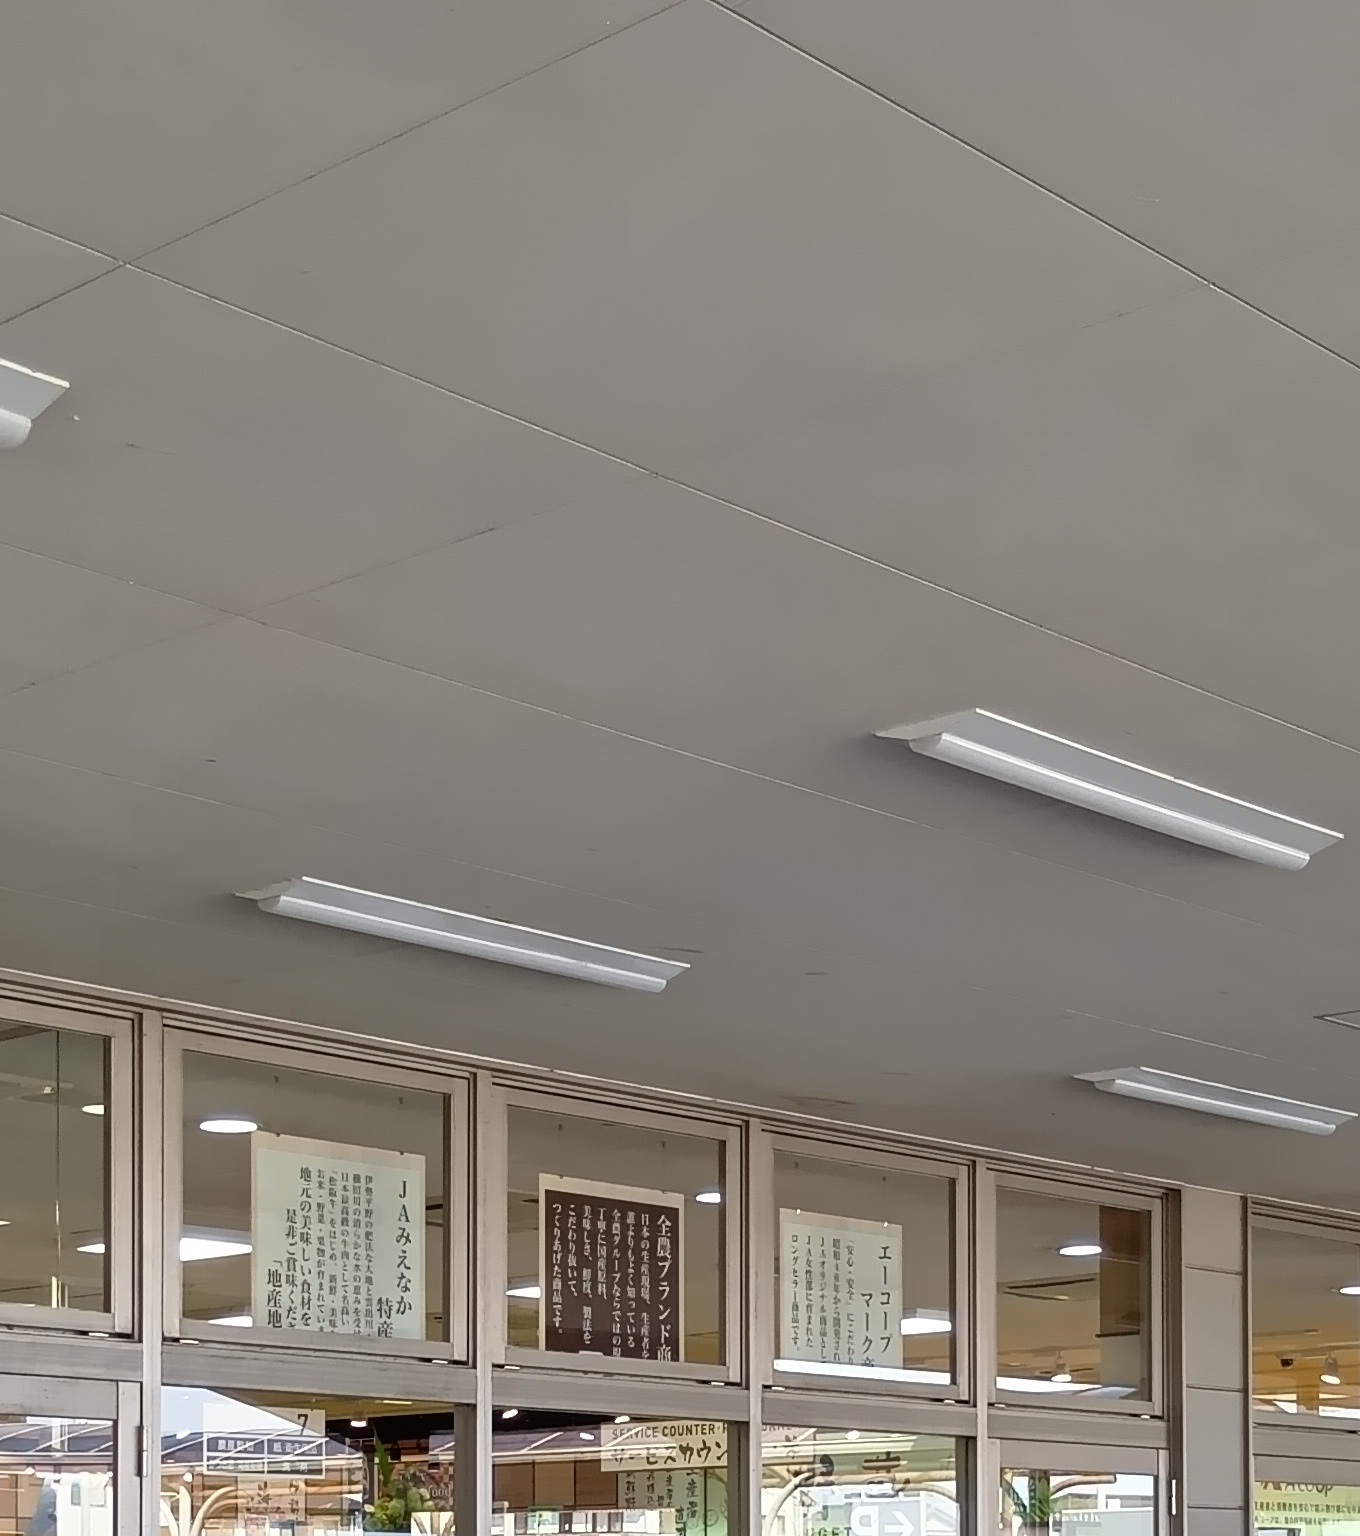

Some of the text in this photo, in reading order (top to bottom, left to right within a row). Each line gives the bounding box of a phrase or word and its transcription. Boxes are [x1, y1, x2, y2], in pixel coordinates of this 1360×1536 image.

[300, 1167, 312, 1326] 地元の美味しい食材を
[395, 1180, 412, 1315] JAみえなか
[878, 1245, 892, 1353] エーコープ
[297, 1413, 308, 1436] 7
[612, 1423, 715, 1440] SERVICE COUNTER
